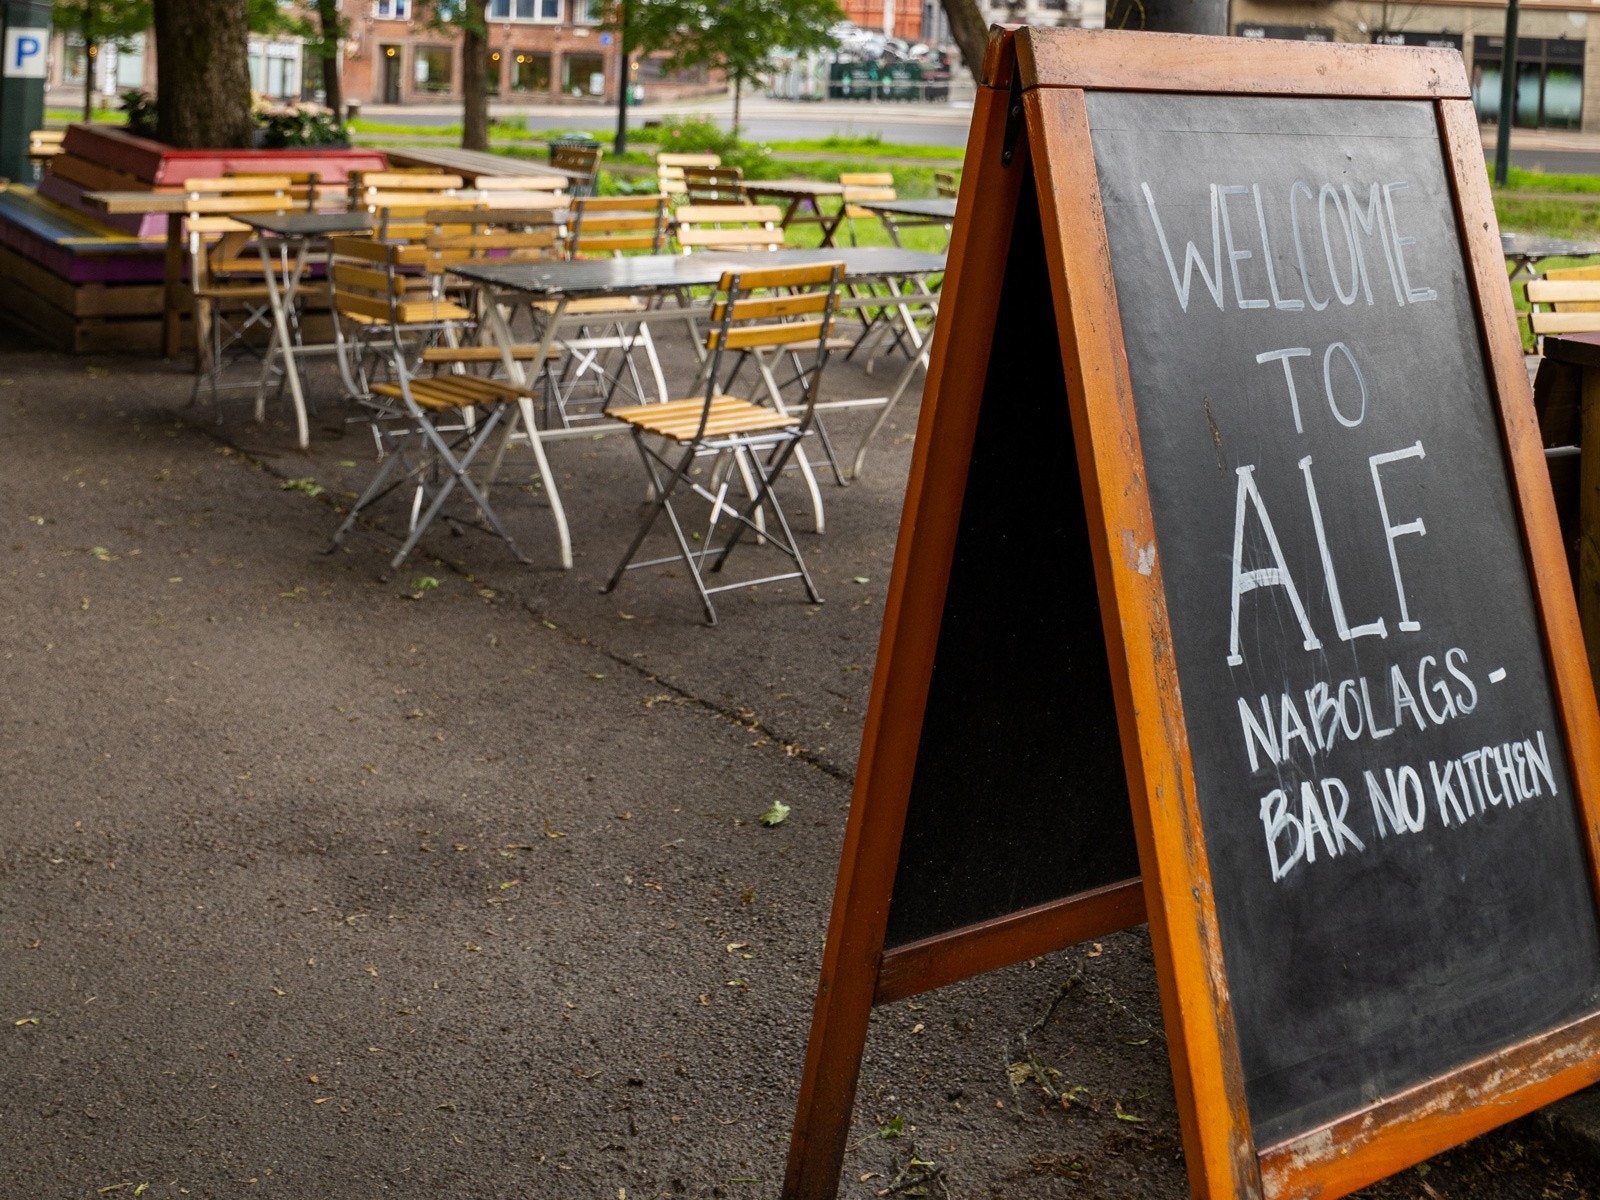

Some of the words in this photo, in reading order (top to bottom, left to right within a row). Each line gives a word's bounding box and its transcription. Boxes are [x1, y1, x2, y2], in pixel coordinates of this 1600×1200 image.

[16, 36, 39, 68] P
[1141, 177, 1438, 313] WELCOME
[1256, 342, 1368, 434] TO
[1227, 440, 1427, 666] ALF
[1260, 777, 1367, 883] BAR
[1363, 766, 1425, 839] NO
[1429, 730, 1559, 829] KITCHEN
